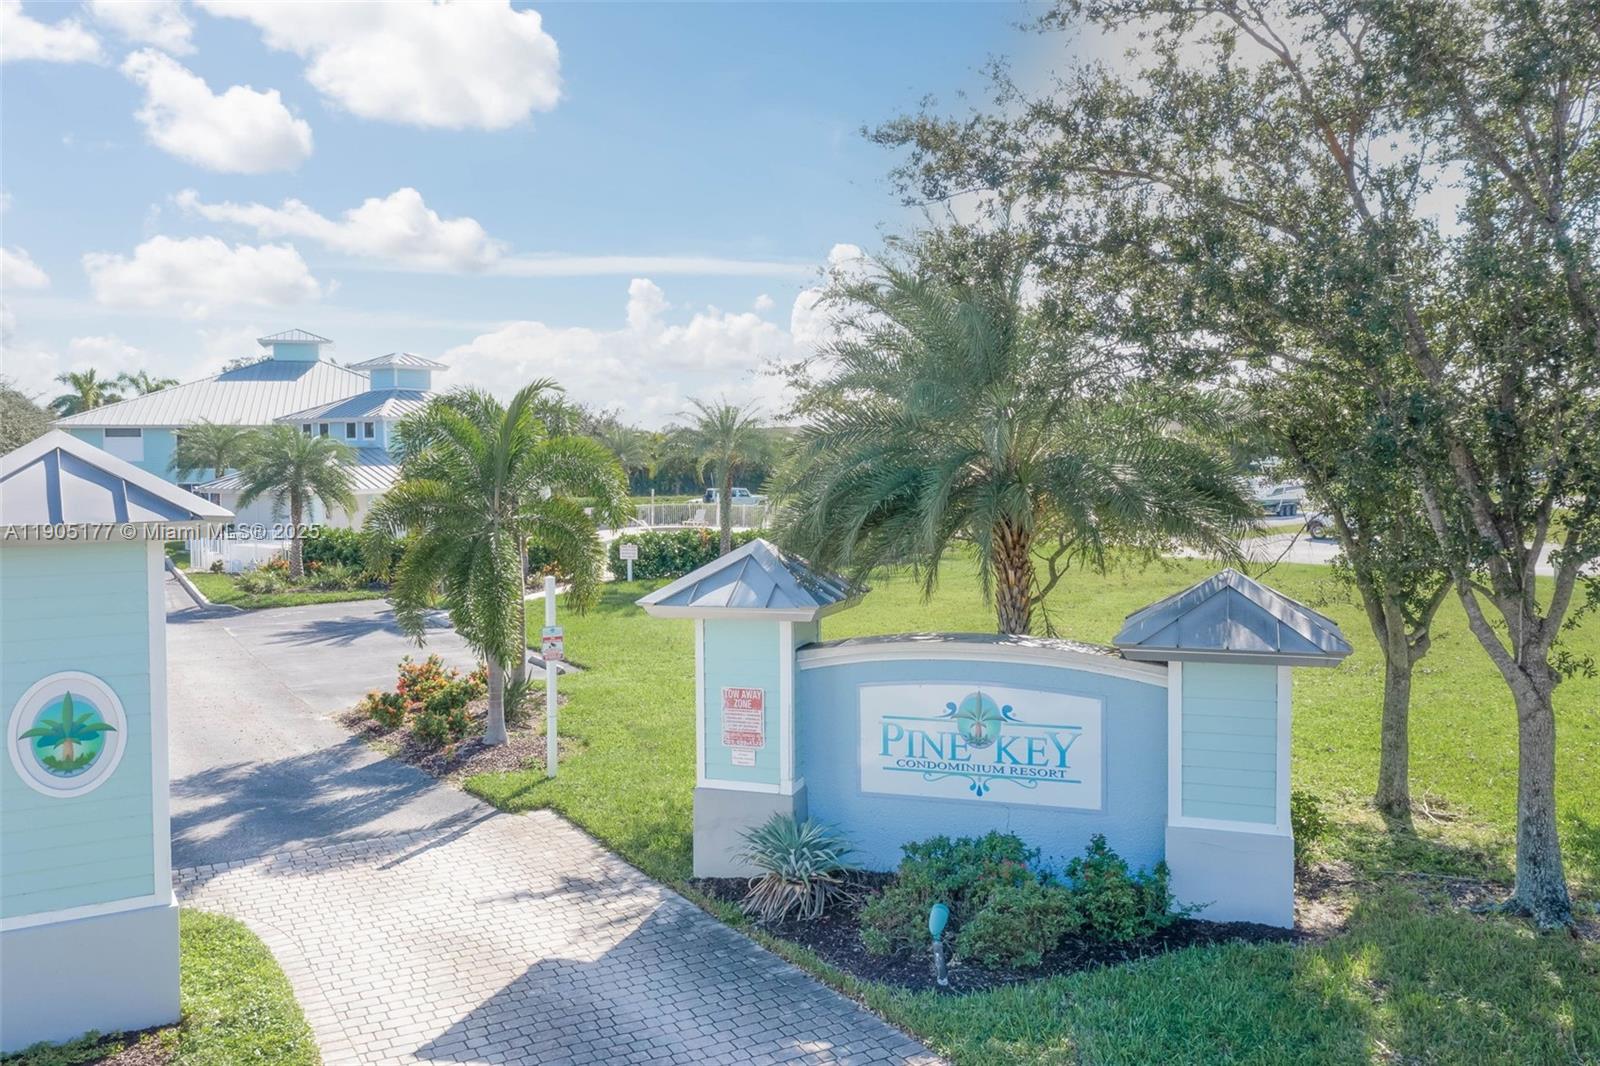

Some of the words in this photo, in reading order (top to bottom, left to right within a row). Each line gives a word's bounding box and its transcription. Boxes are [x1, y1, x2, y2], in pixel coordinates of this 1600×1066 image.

[741, 689, 762, 699] AWAY
[733, 699, 753, 709] ZONE
[879, 721, 972, 762] PINE
[994, 731, 1082, 769] KEY
[896, 758, 1006, 776] CONDOMINIUM
[1009, 766, 1067, 779] RESORT
